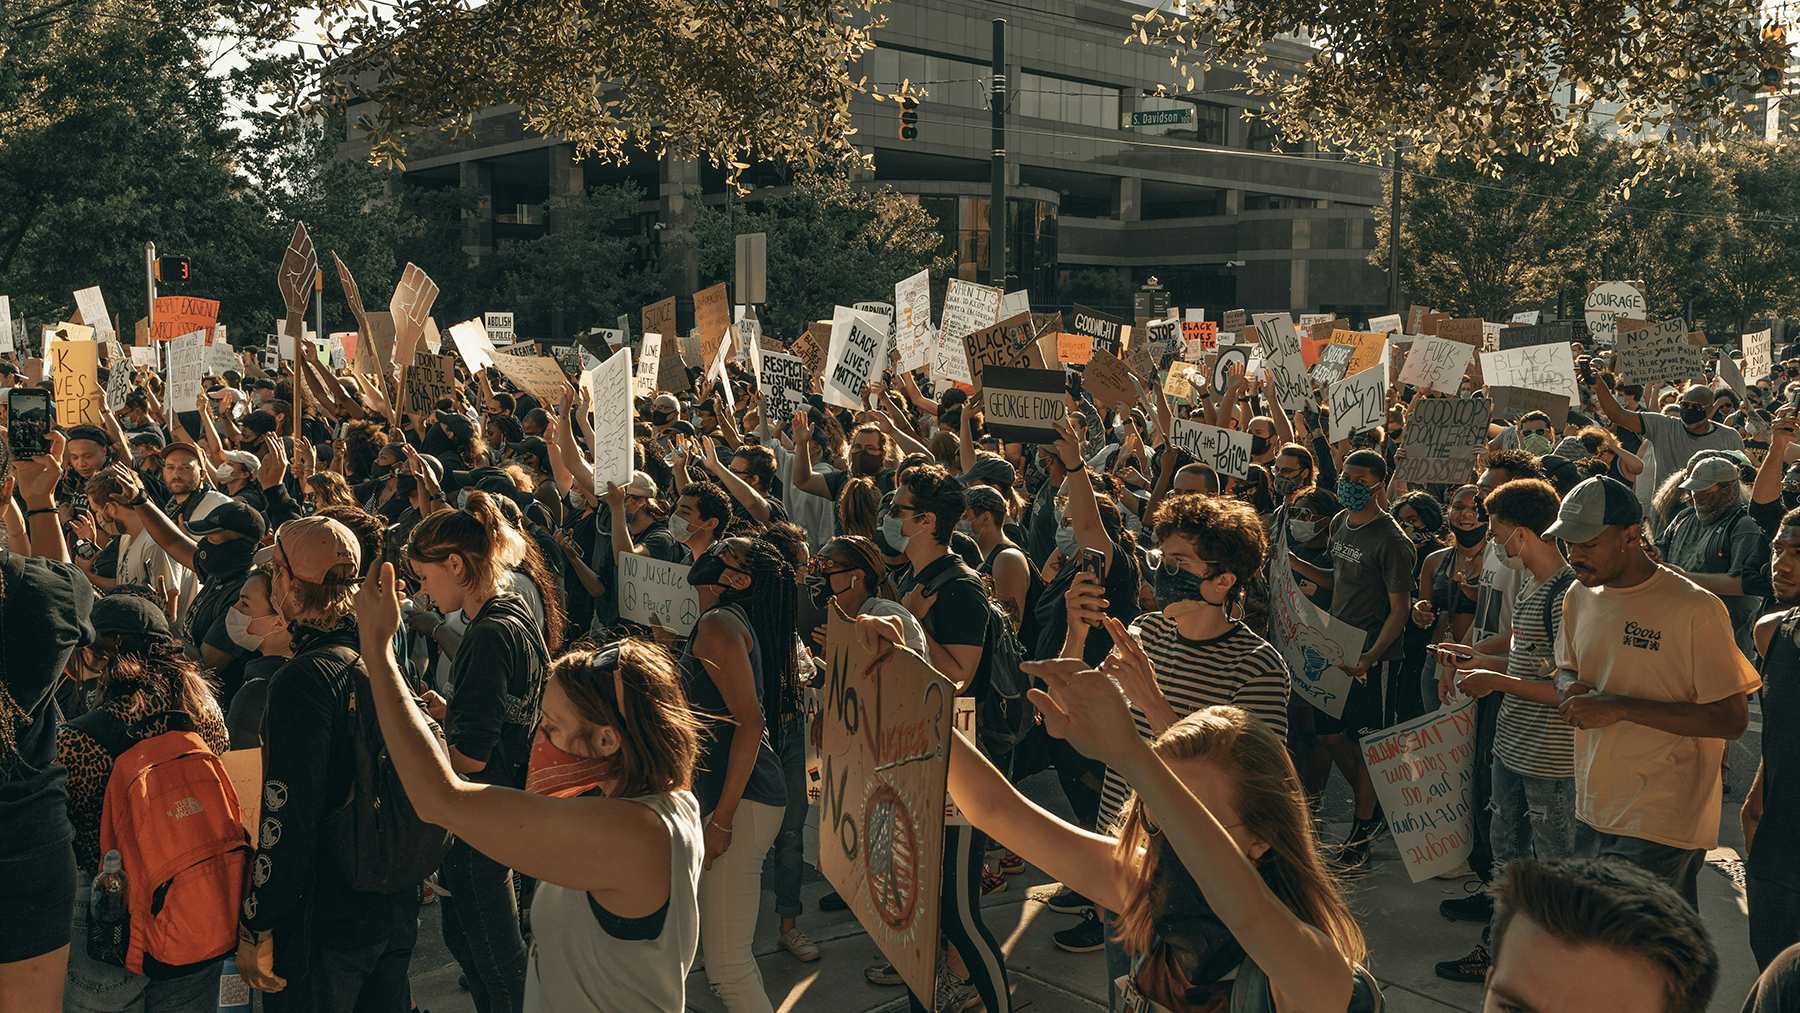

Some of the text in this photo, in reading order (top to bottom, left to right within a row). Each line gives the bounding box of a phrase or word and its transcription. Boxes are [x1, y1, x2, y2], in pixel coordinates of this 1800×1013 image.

[1142, 112, 1178, 124] Davidson
[181, 262, 189, 279] 3
[1588, 292, 1641, 309] COURAGE
[487, 316, 512, 328] ABOLISH
[1182, 322, 1212, 331] BLACK
[496, 331, 511, 340] POLICE
[966, 325, 1012, 357] BLACK
[1148, 323, 1176, 341] STOP
[1183, 332, 1212, 342] LIVES
[1334, 332, 1364, 347] BLACK
[1627, 329, 1649, 344] NO
[1751, 332, 1764, 343] NO
[848, 325, 877, 358] BLACK
[644, 343, 659, 359] LOVE
[972, 344, 1015, 376] LIVES
[1424, 340, 1456, 368] FUCK
[1494, 346, 1559, 371] BLACK
[763, 355, 803, 378] RESPECT
[843, 347, 870, 378] LIVES
[1752, 355, 1764, 366] NO
[54, 374, 87, 397] VES
[771, 385, 785, 399] OR
[55, 398, 93, 426] TER
[989, 392, 1065, 421] GEORGE FLOYD
[1356, 381, 1385, 431] 12!!
[1414, 399, 1452, 426] GOOD
[1201, 435, 1215, 449] the
[1425, 442, 1451, 459] THE
[1401, 457, 1430, 482] BAD
[623, 556, 638, 578] NO
[1624, 620, 1662, 641] Coors
